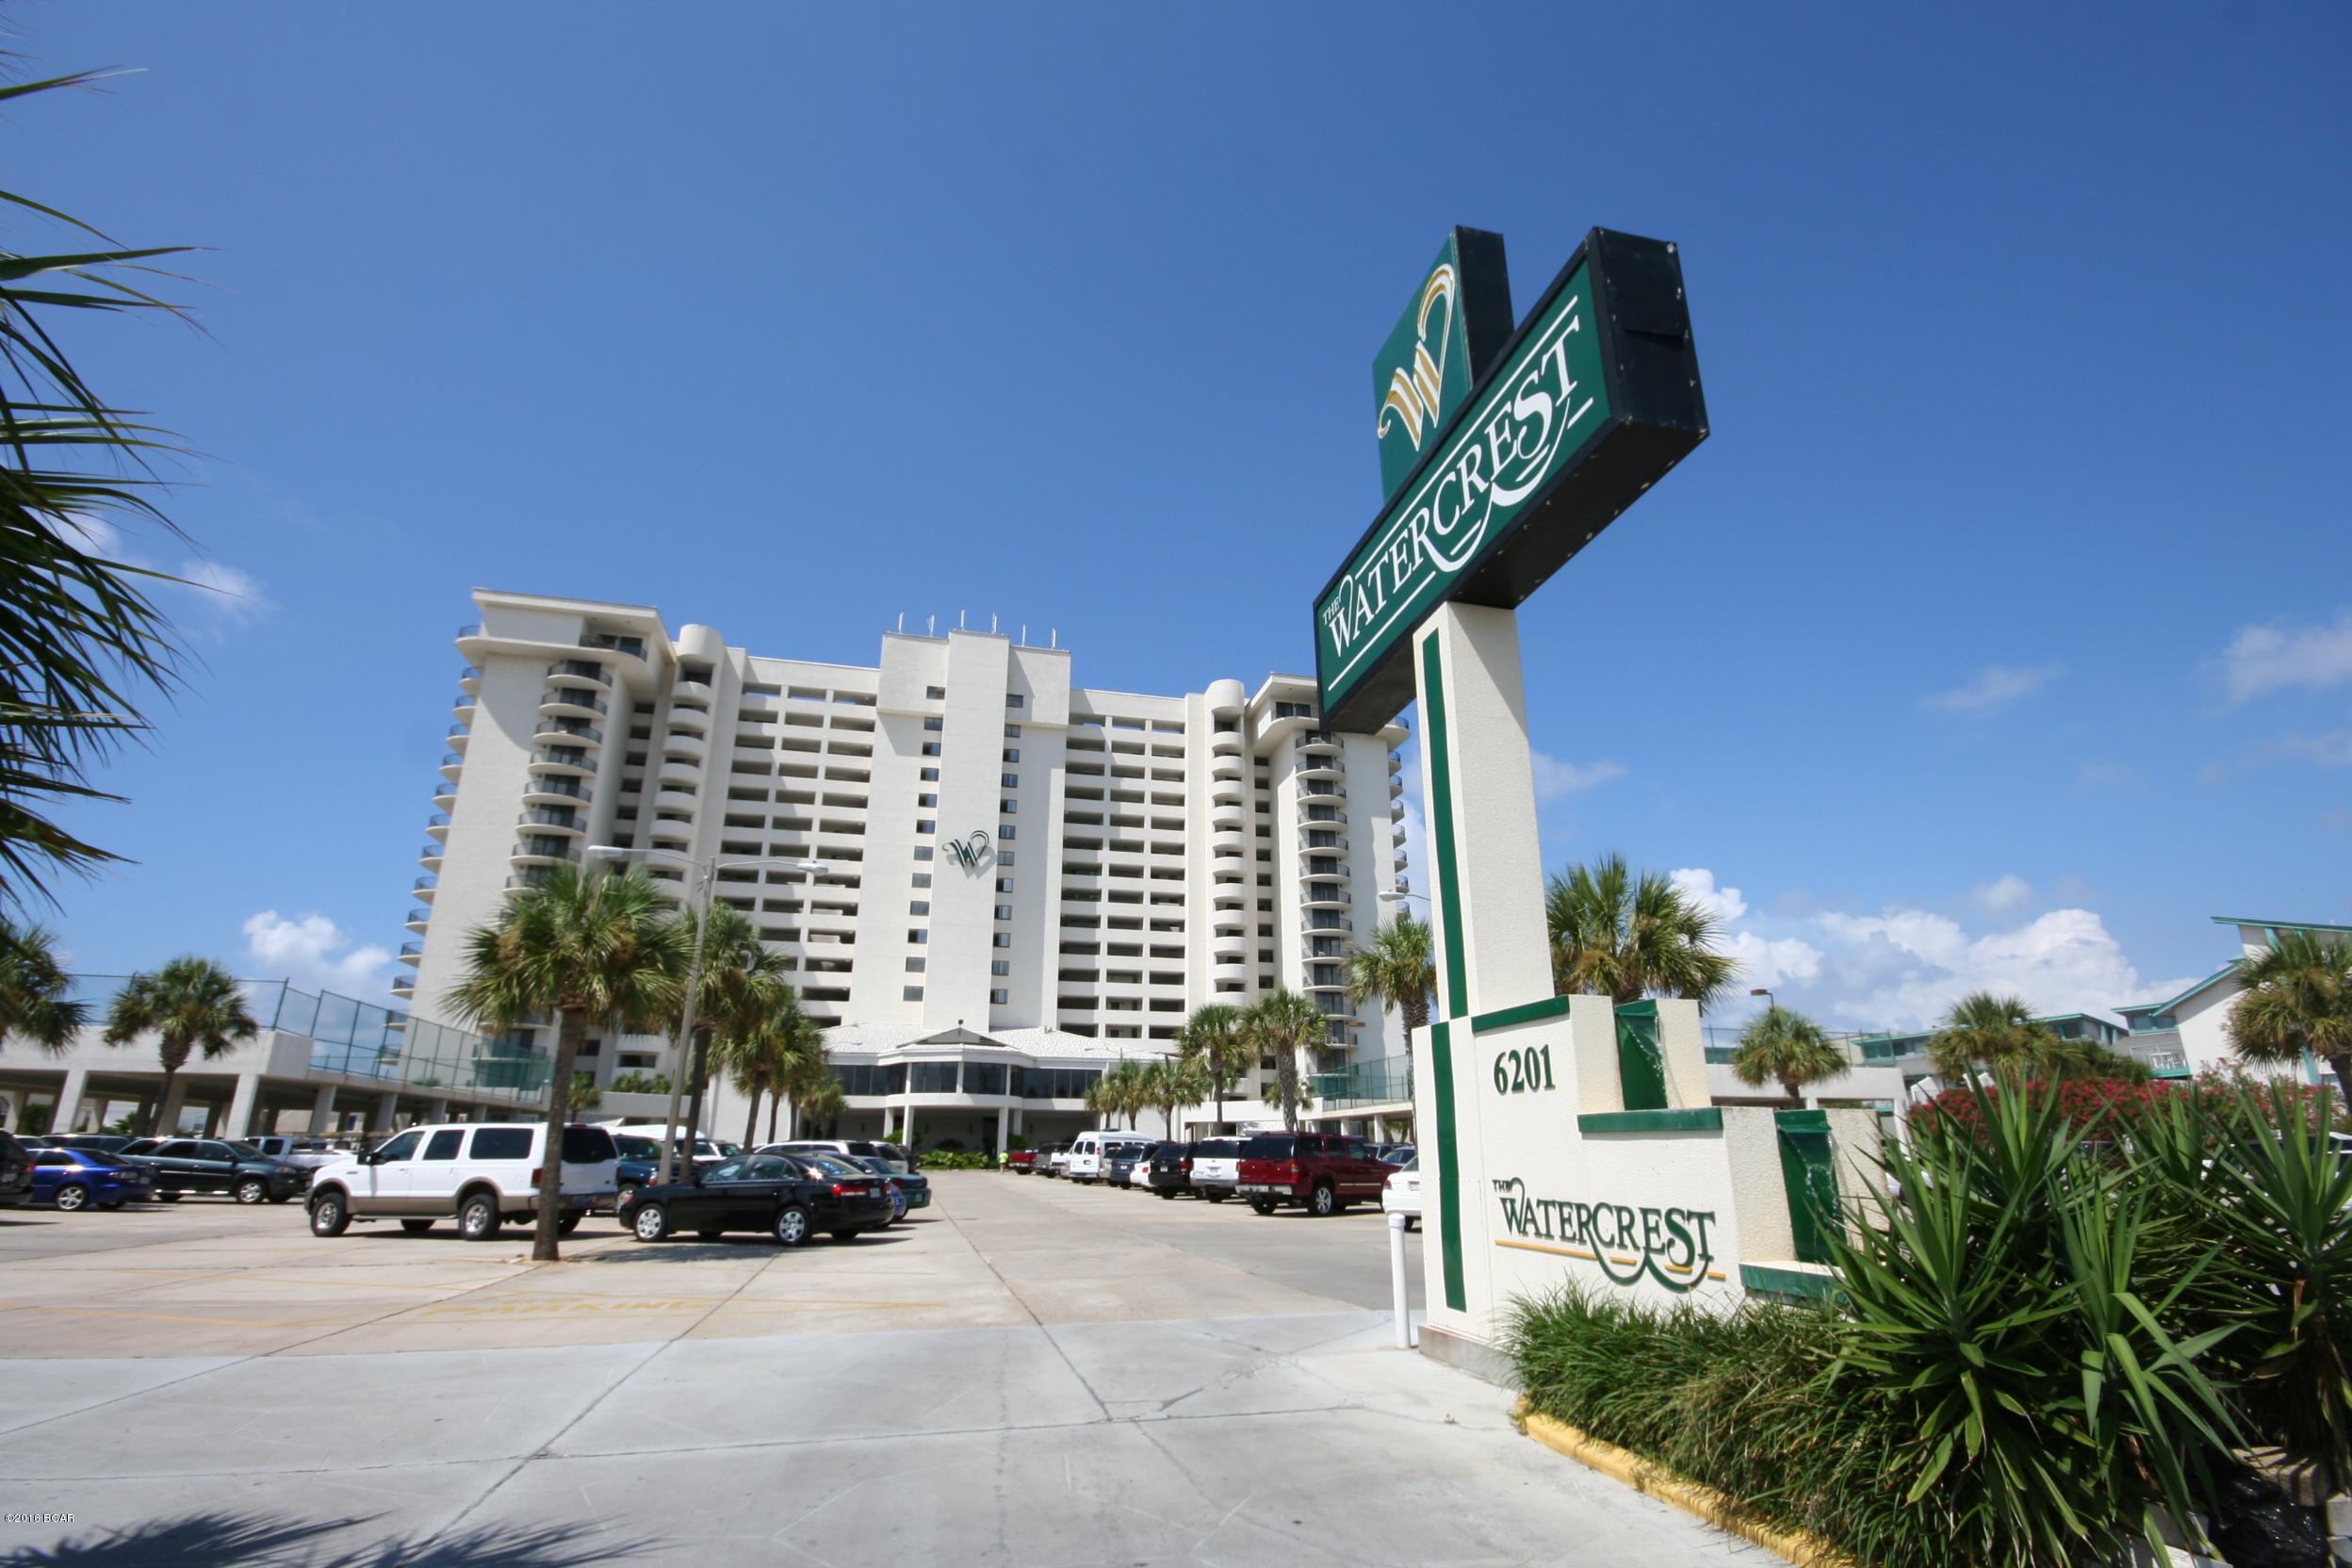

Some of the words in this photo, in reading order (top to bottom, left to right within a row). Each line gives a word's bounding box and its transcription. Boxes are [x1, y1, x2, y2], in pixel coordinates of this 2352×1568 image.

[1328, 314, 1581, 658] WATERCREST
[1322, 596, 1340, 627] THE
[1494, 1043, 1556, 1096] 6201
[1499, 1177, 1716, 1294] WATERCREST
[419, 1300, 713, 1317] PARKING
